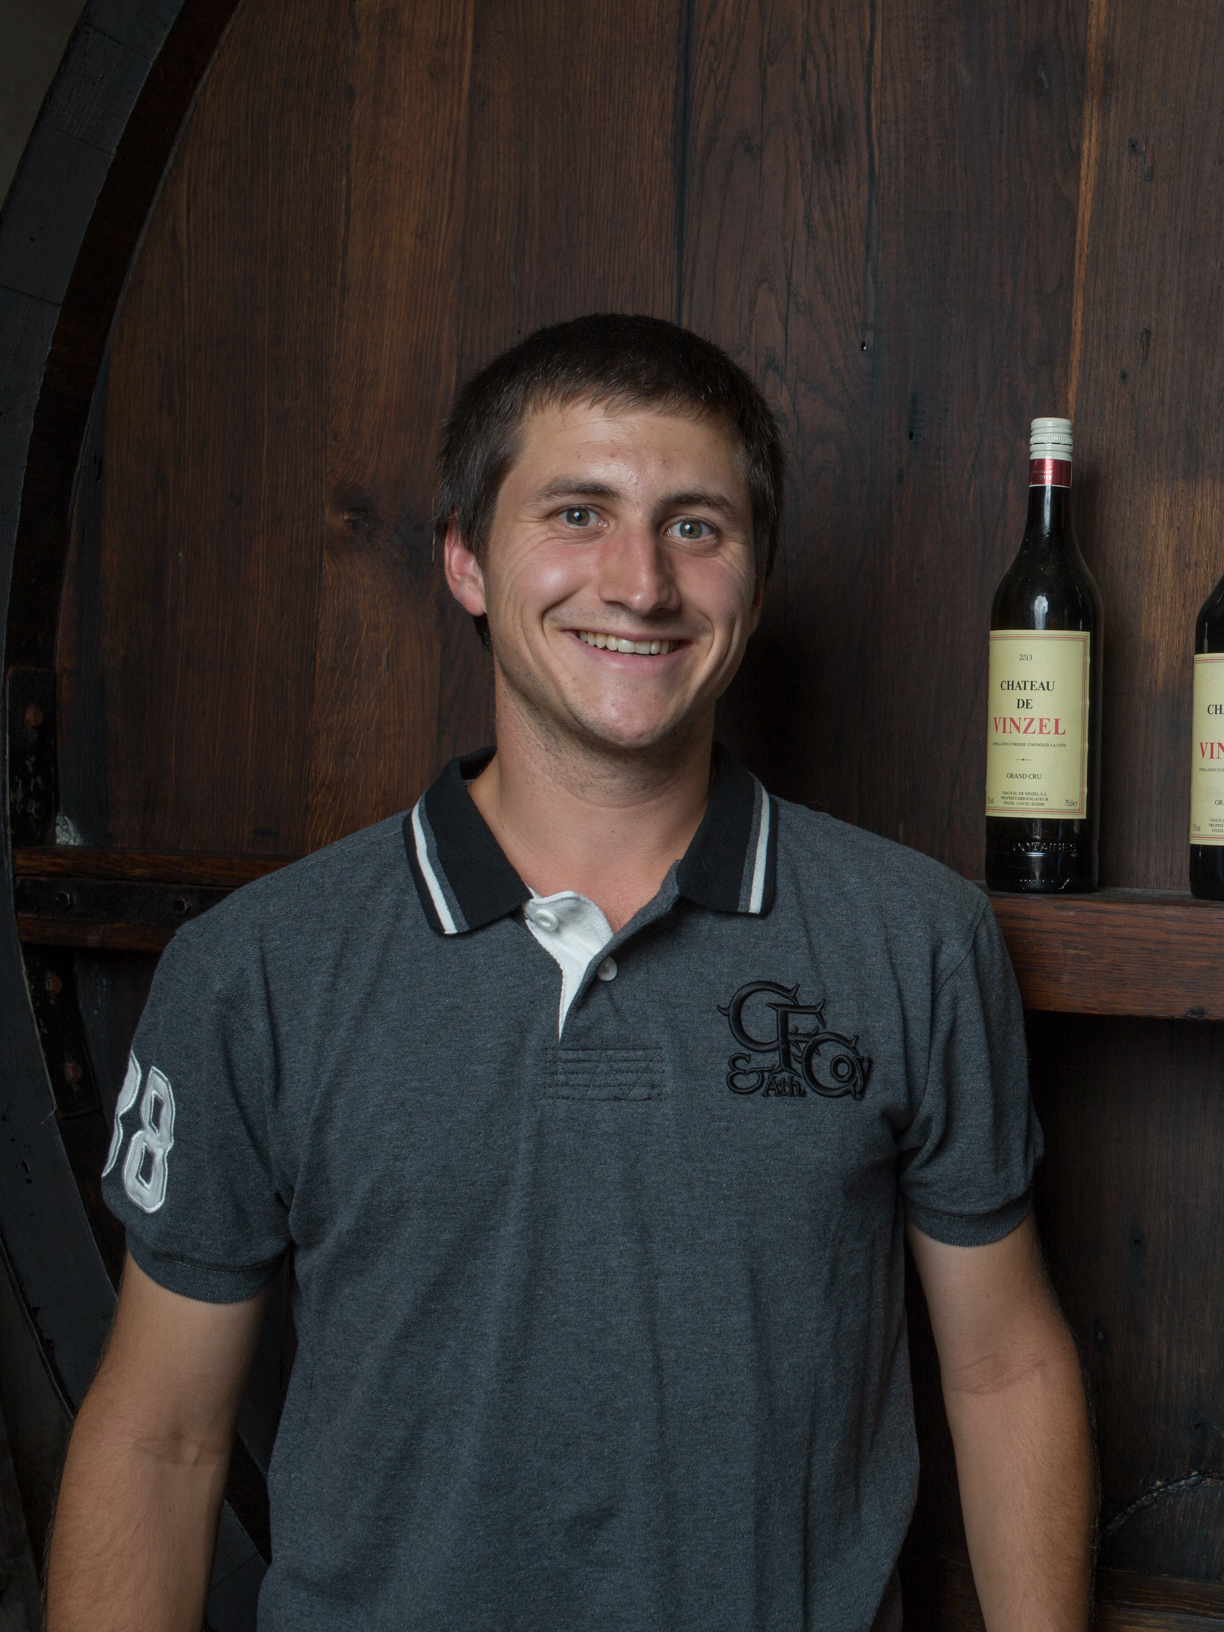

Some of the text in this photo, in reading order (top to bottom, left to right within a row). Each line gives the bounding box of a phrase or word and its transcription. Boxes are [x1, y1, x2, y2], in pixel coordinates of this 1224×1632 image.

[1000, 680, 1055, 691] CHATEAU
[1016, 699, 1033, 709] DE
[993, 717, 1067, 735] VINZEL
